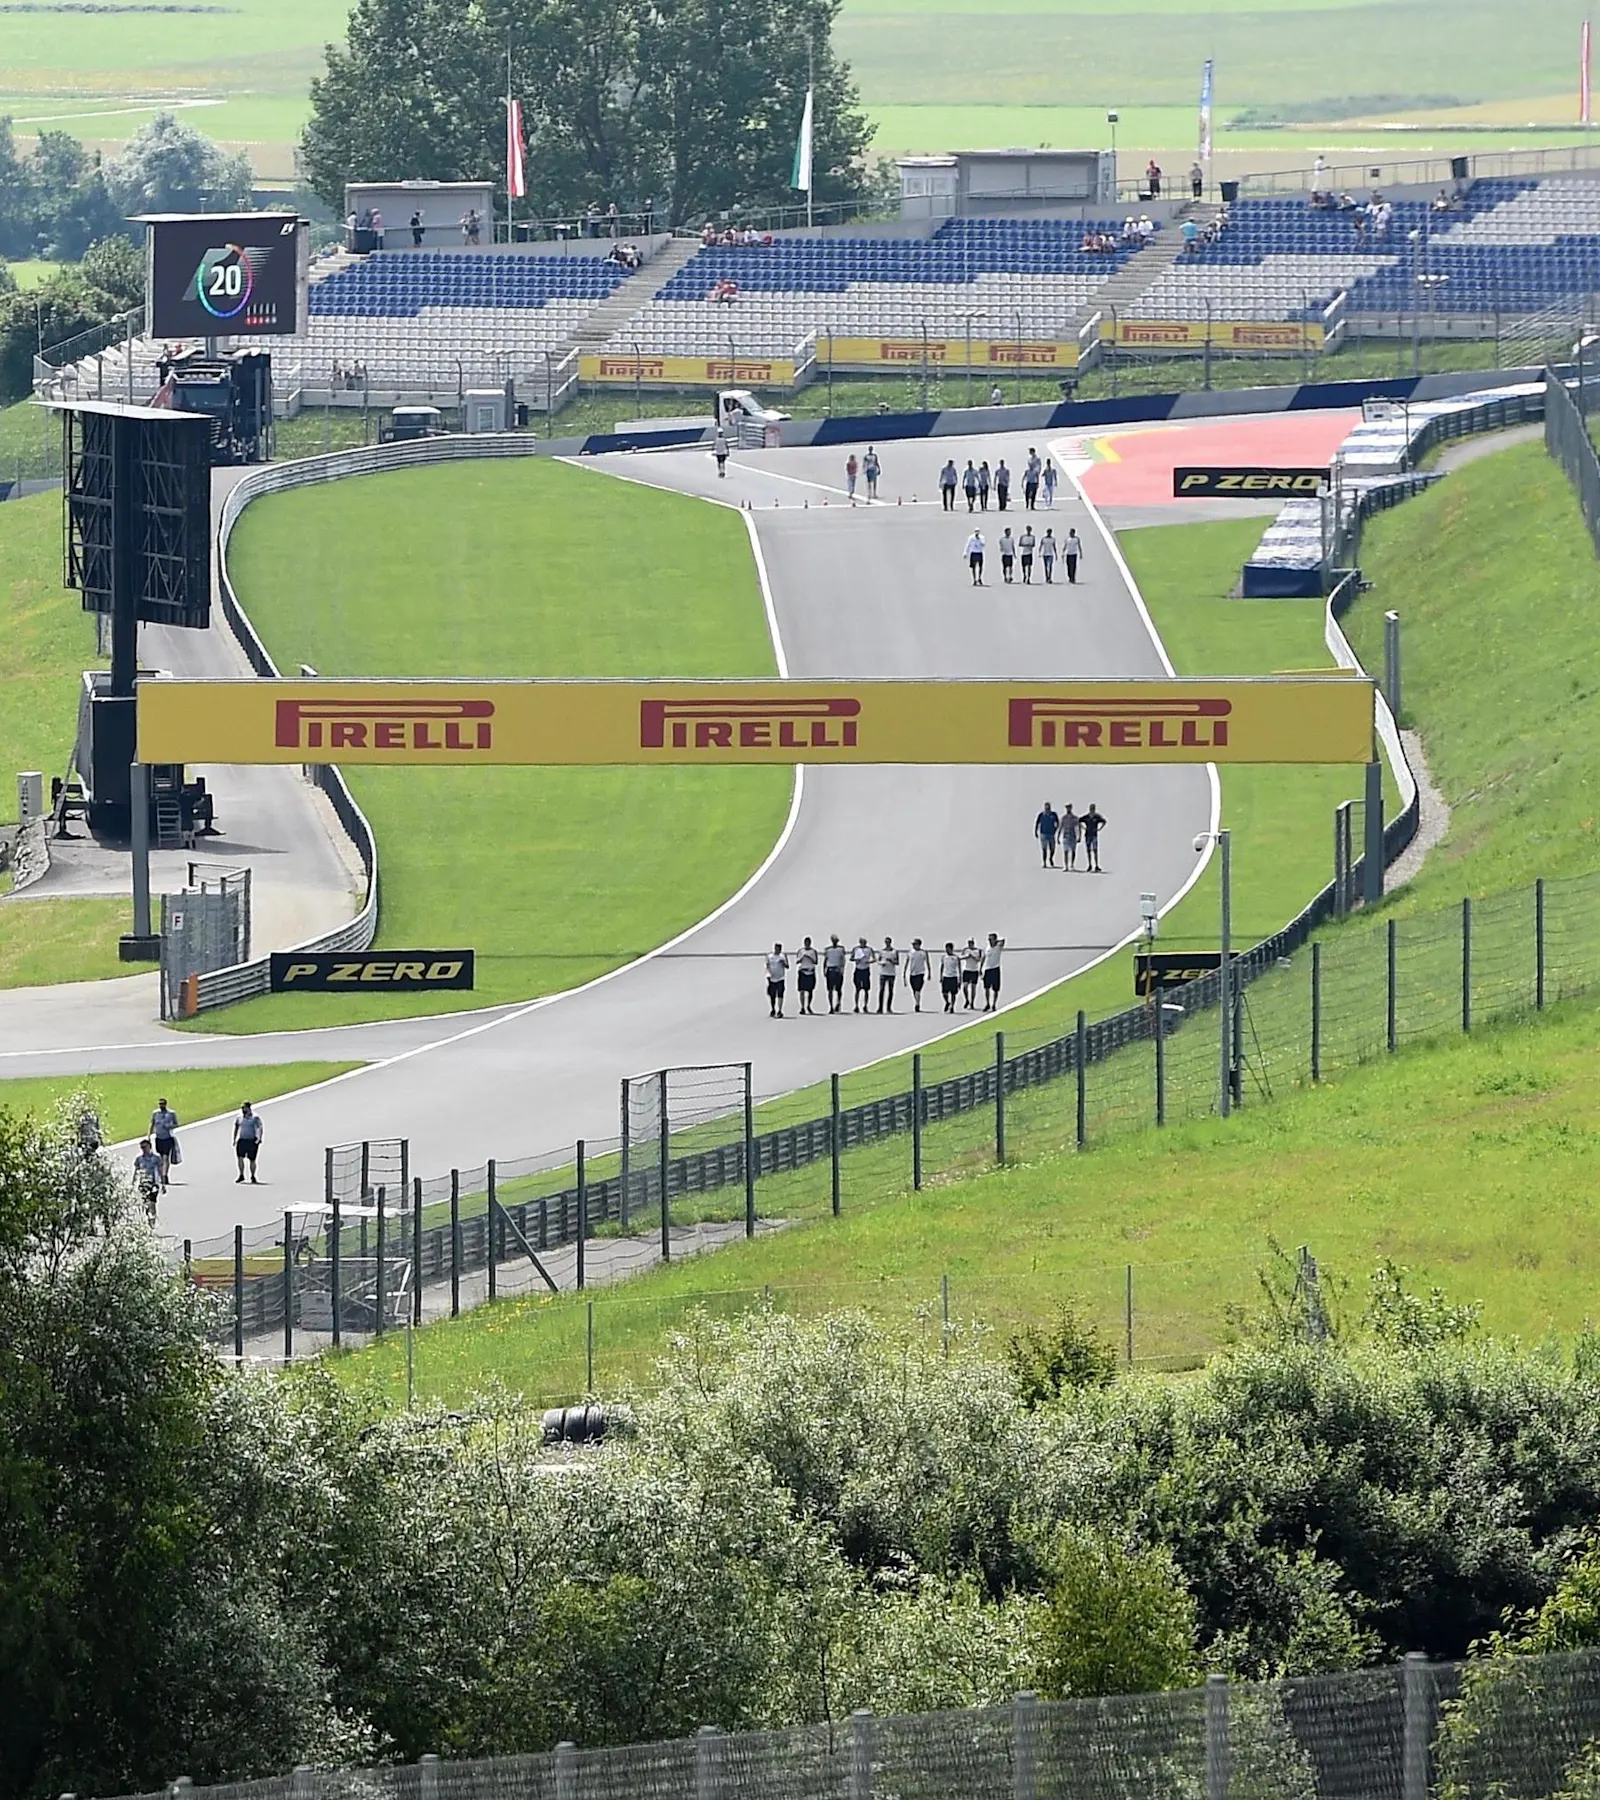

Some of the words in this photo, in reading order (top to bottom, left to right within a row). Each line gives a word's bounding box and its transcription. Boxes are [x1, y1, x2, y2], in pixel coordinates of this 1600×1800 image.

[209, 265, 241, 296] 20
[1123, 325, 1188, 342] PIRELLI
[990, 345, 1056, 362] PIRELLI
[1180, 475, 1210, 490] P
[1214, 475, 1323, 490] ZERO
[275, 700, 495, 749] PIRELLI
[640, 698, 861, 748] PIRELLI
[1008, 698, 1232, 747] PIRELLI
[175, 916, 181, 926] F
[283, 964, 318, 982] P
[326, 961, 464, 981] ZERO
